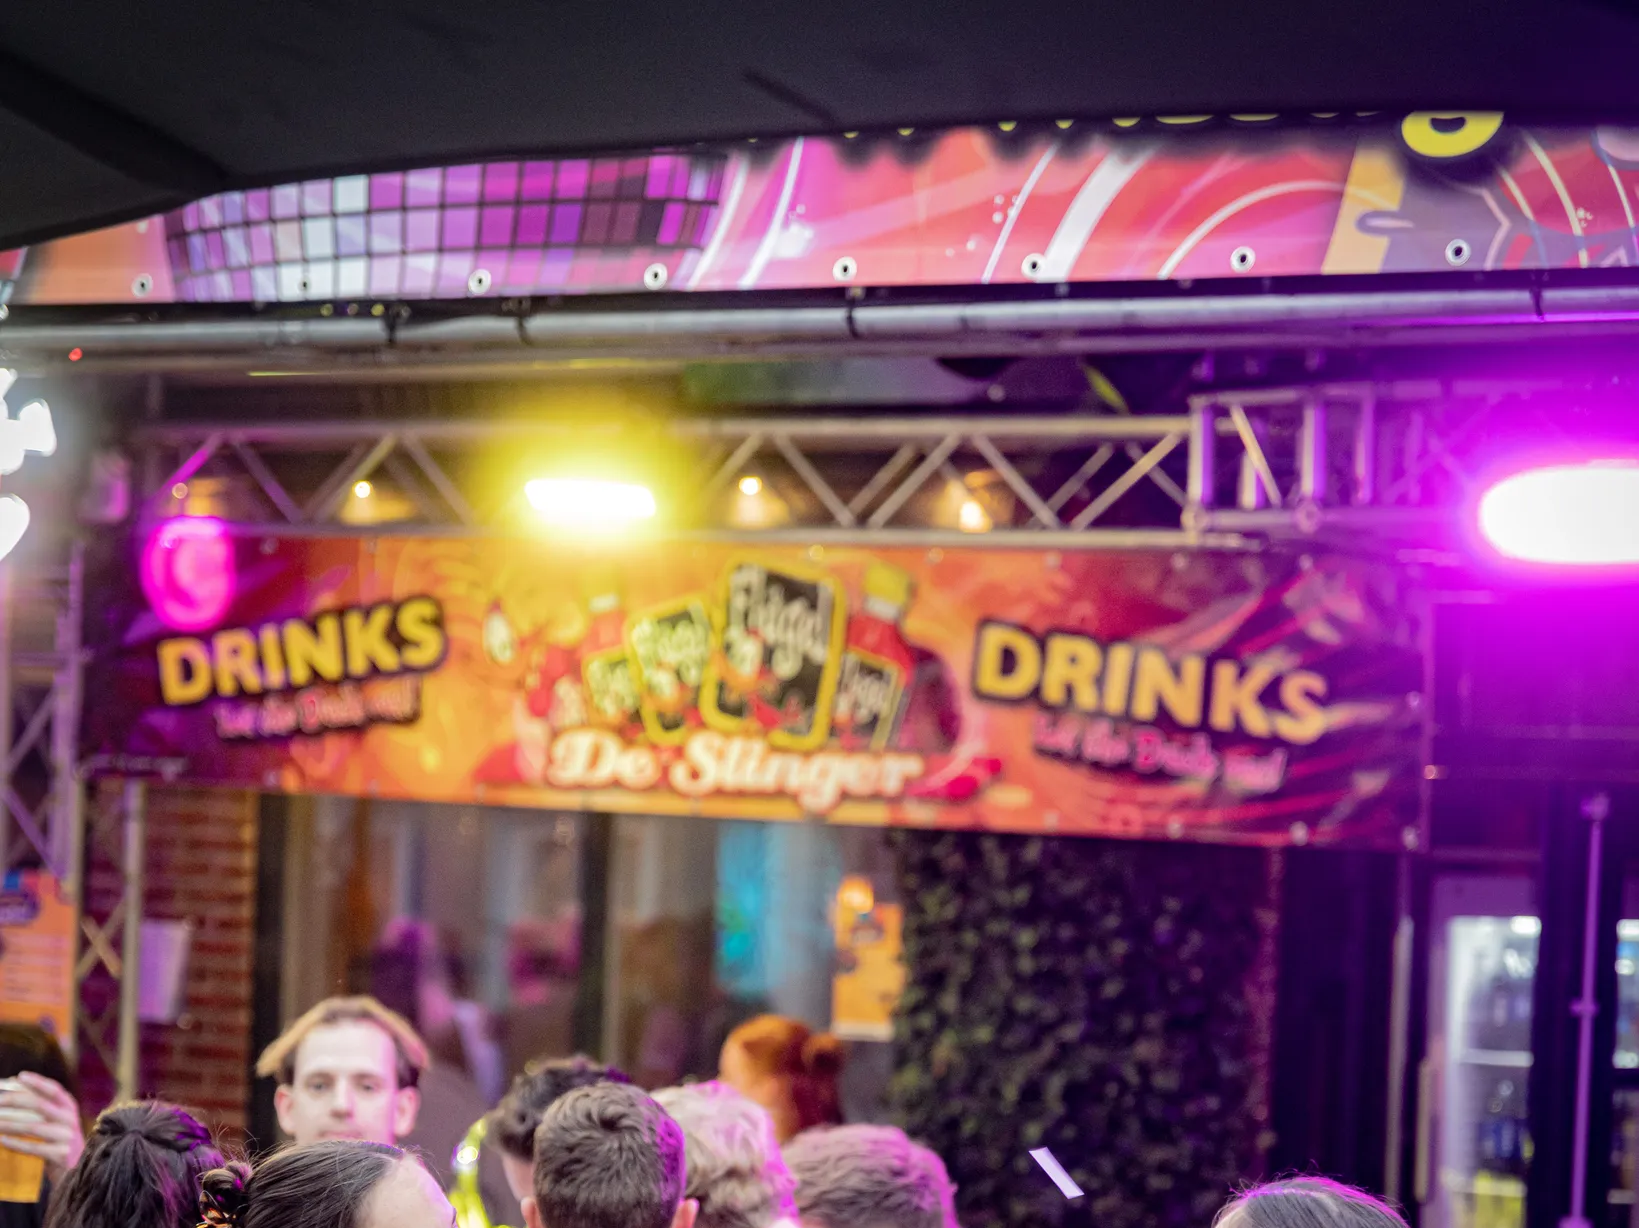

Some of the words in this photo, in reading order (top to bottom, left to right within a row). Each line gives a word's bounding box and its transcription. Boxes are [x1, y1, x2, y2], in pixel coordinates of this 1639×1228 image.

[158, 597, 444, 705] DRINKS
[975, 622, 1330, 744] DRINKS
[549, 730, 660, 788] De
[669, 730, 924, 814] Slinger
